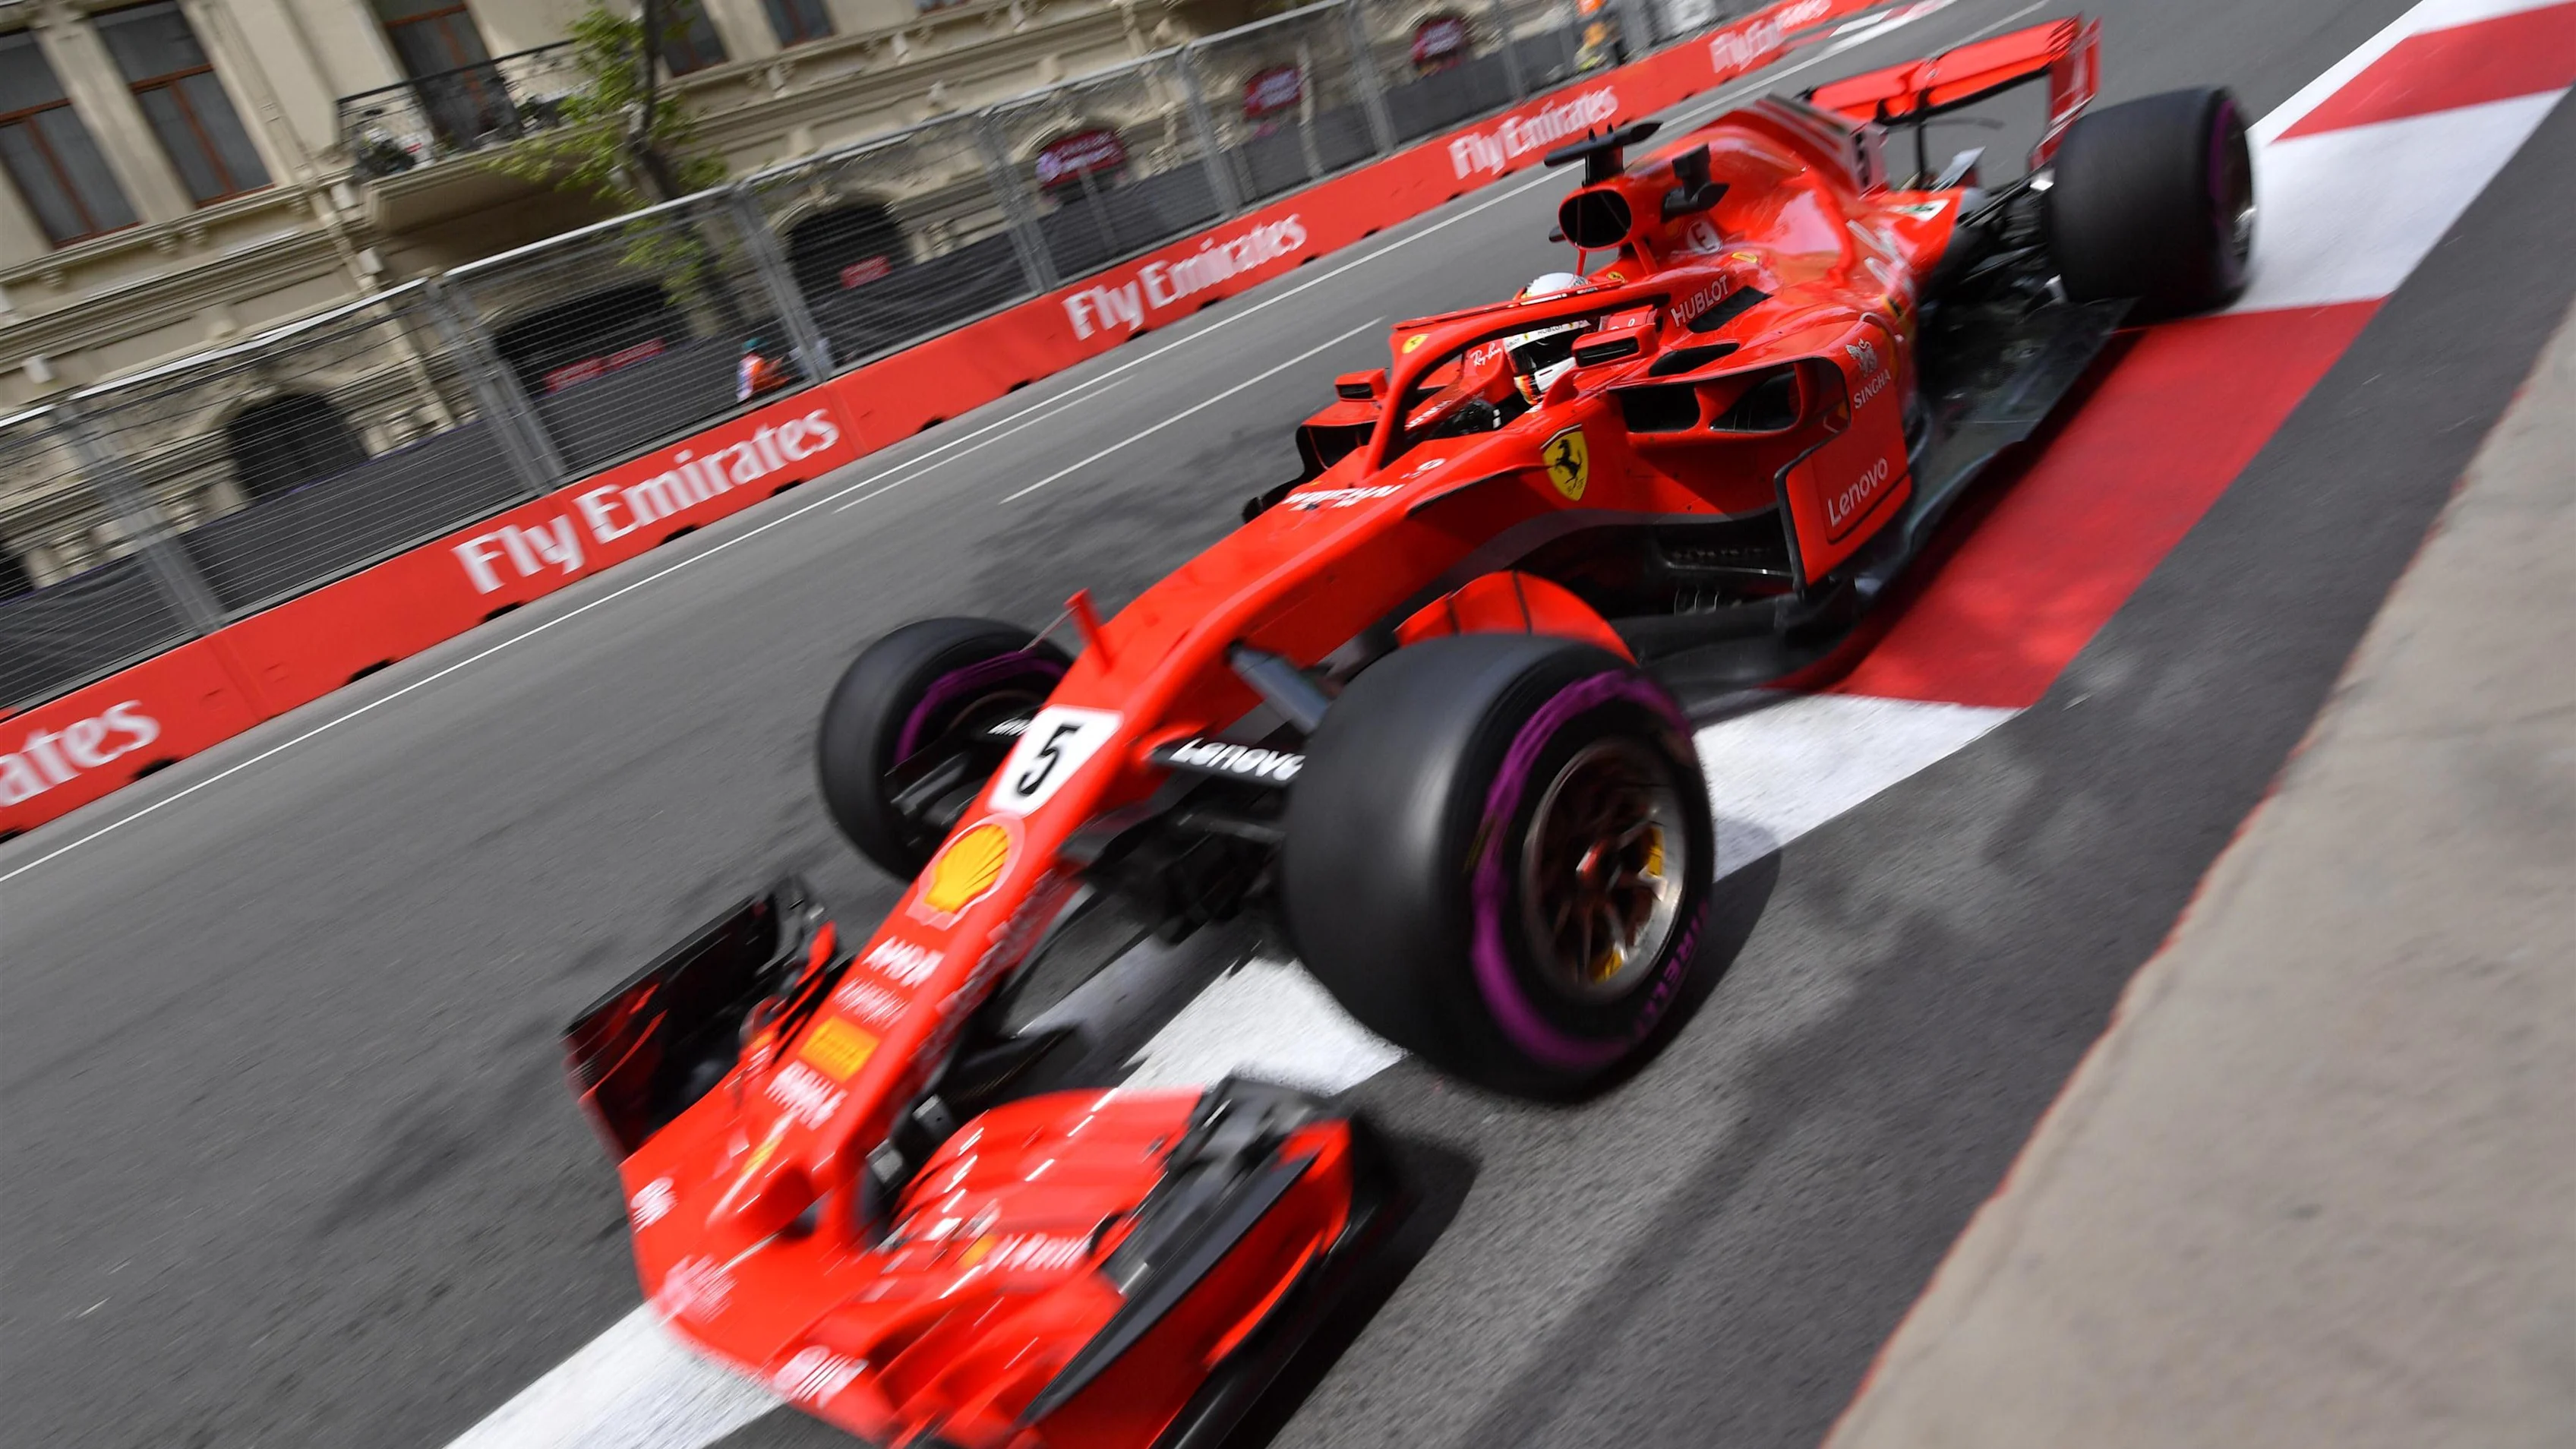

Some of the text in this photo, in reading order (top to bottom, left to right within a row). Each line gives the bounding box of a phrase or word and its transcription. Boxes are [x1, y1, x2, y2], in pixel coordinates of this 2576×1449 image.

[1447, 85, 1619, 179] Fly Emirates
[1062, 213, 1307, 340] Fly Emirates
[1671, 274, 1728, 327] HUBLOT
[1470, 343, 1501, 366] Ray-Ban
[1853, 368, 1891, 409] SINGHA
[451, 408, 839, 595] Fly Emirates
[1827, 457, 1889, 527] Lenovo
[1018, 724, 1086, 796] 5
